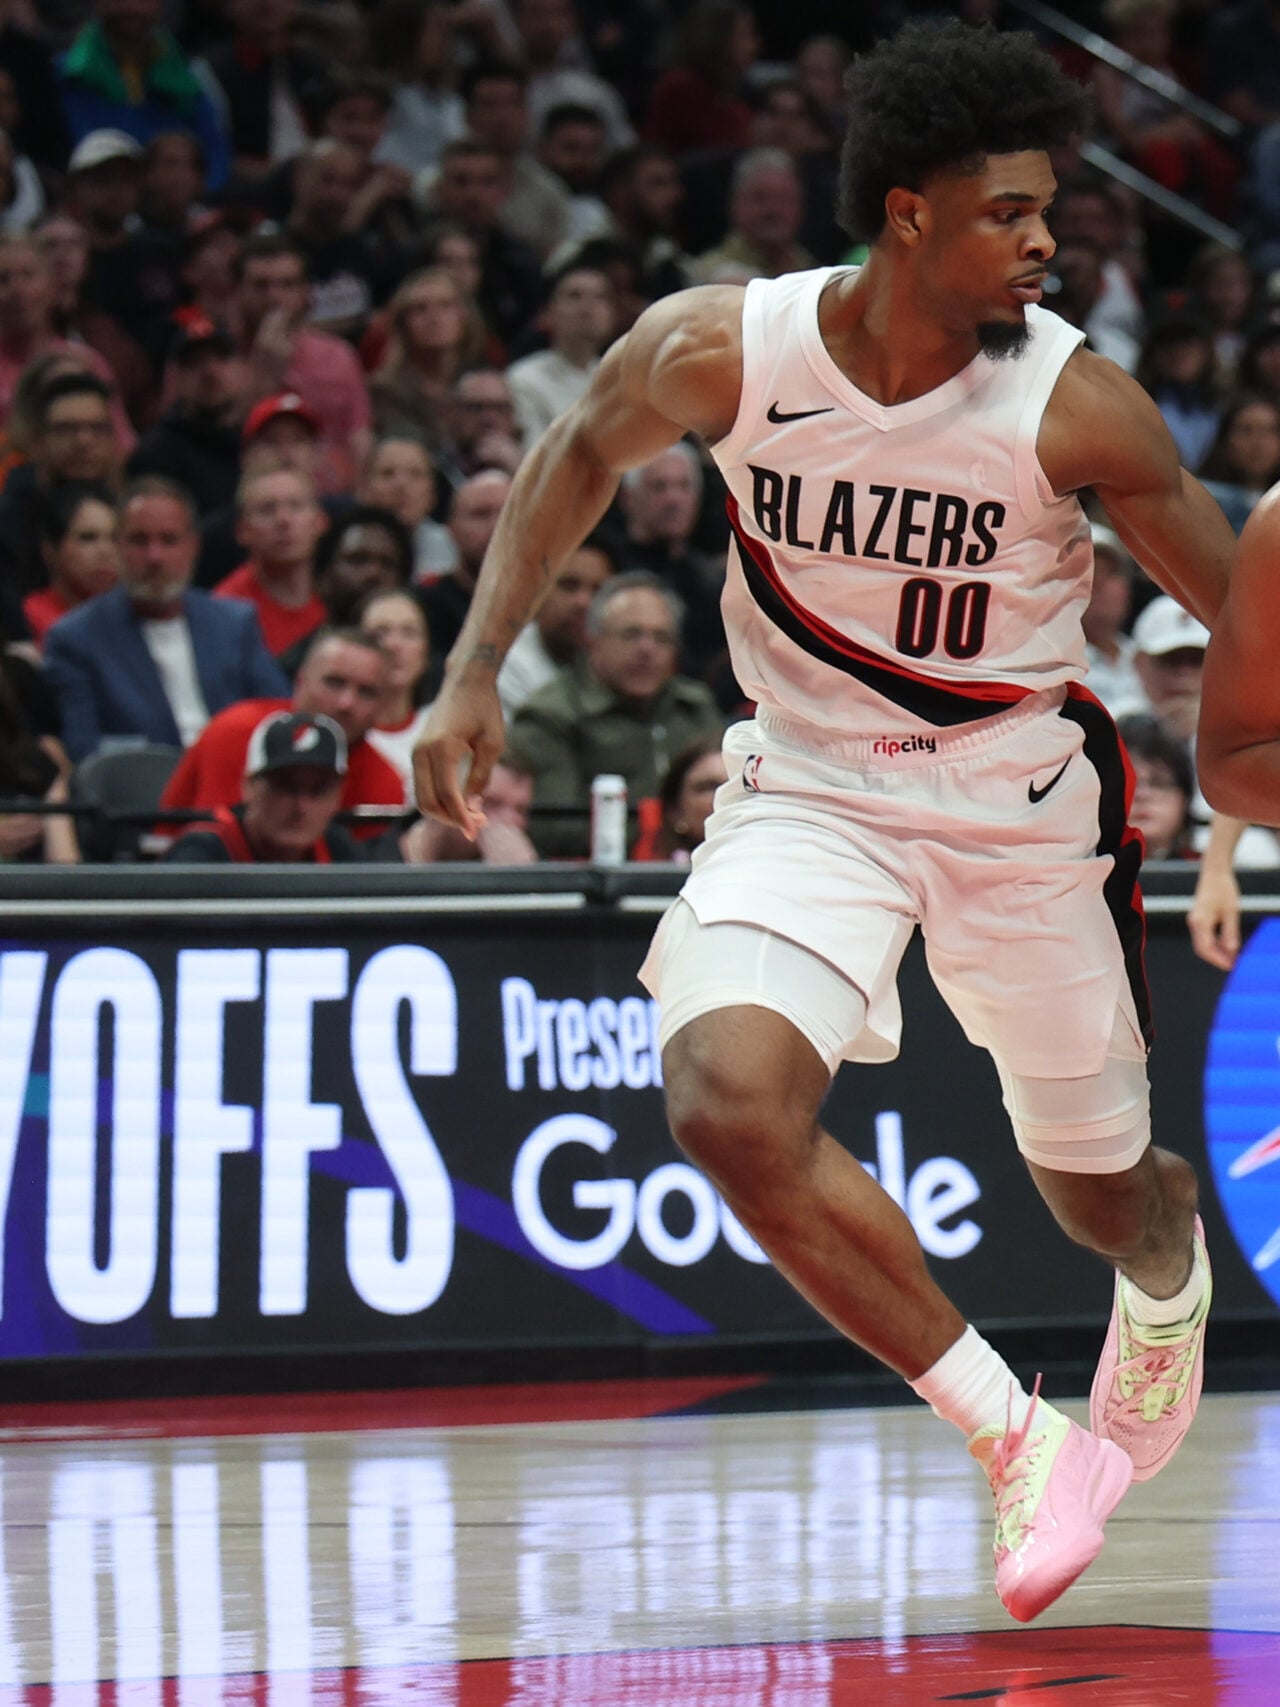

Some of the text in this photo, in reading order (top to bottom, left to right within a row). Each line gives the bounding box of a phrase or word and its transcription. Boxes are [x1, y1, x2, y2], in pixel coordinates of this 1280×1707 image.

[747, 464, 1006, 568] BLAZERS
[895, 577, 992, 660] 00
[873, 735, 937, 758] ripcity
[511, 1111, 983, 1271] Gole
